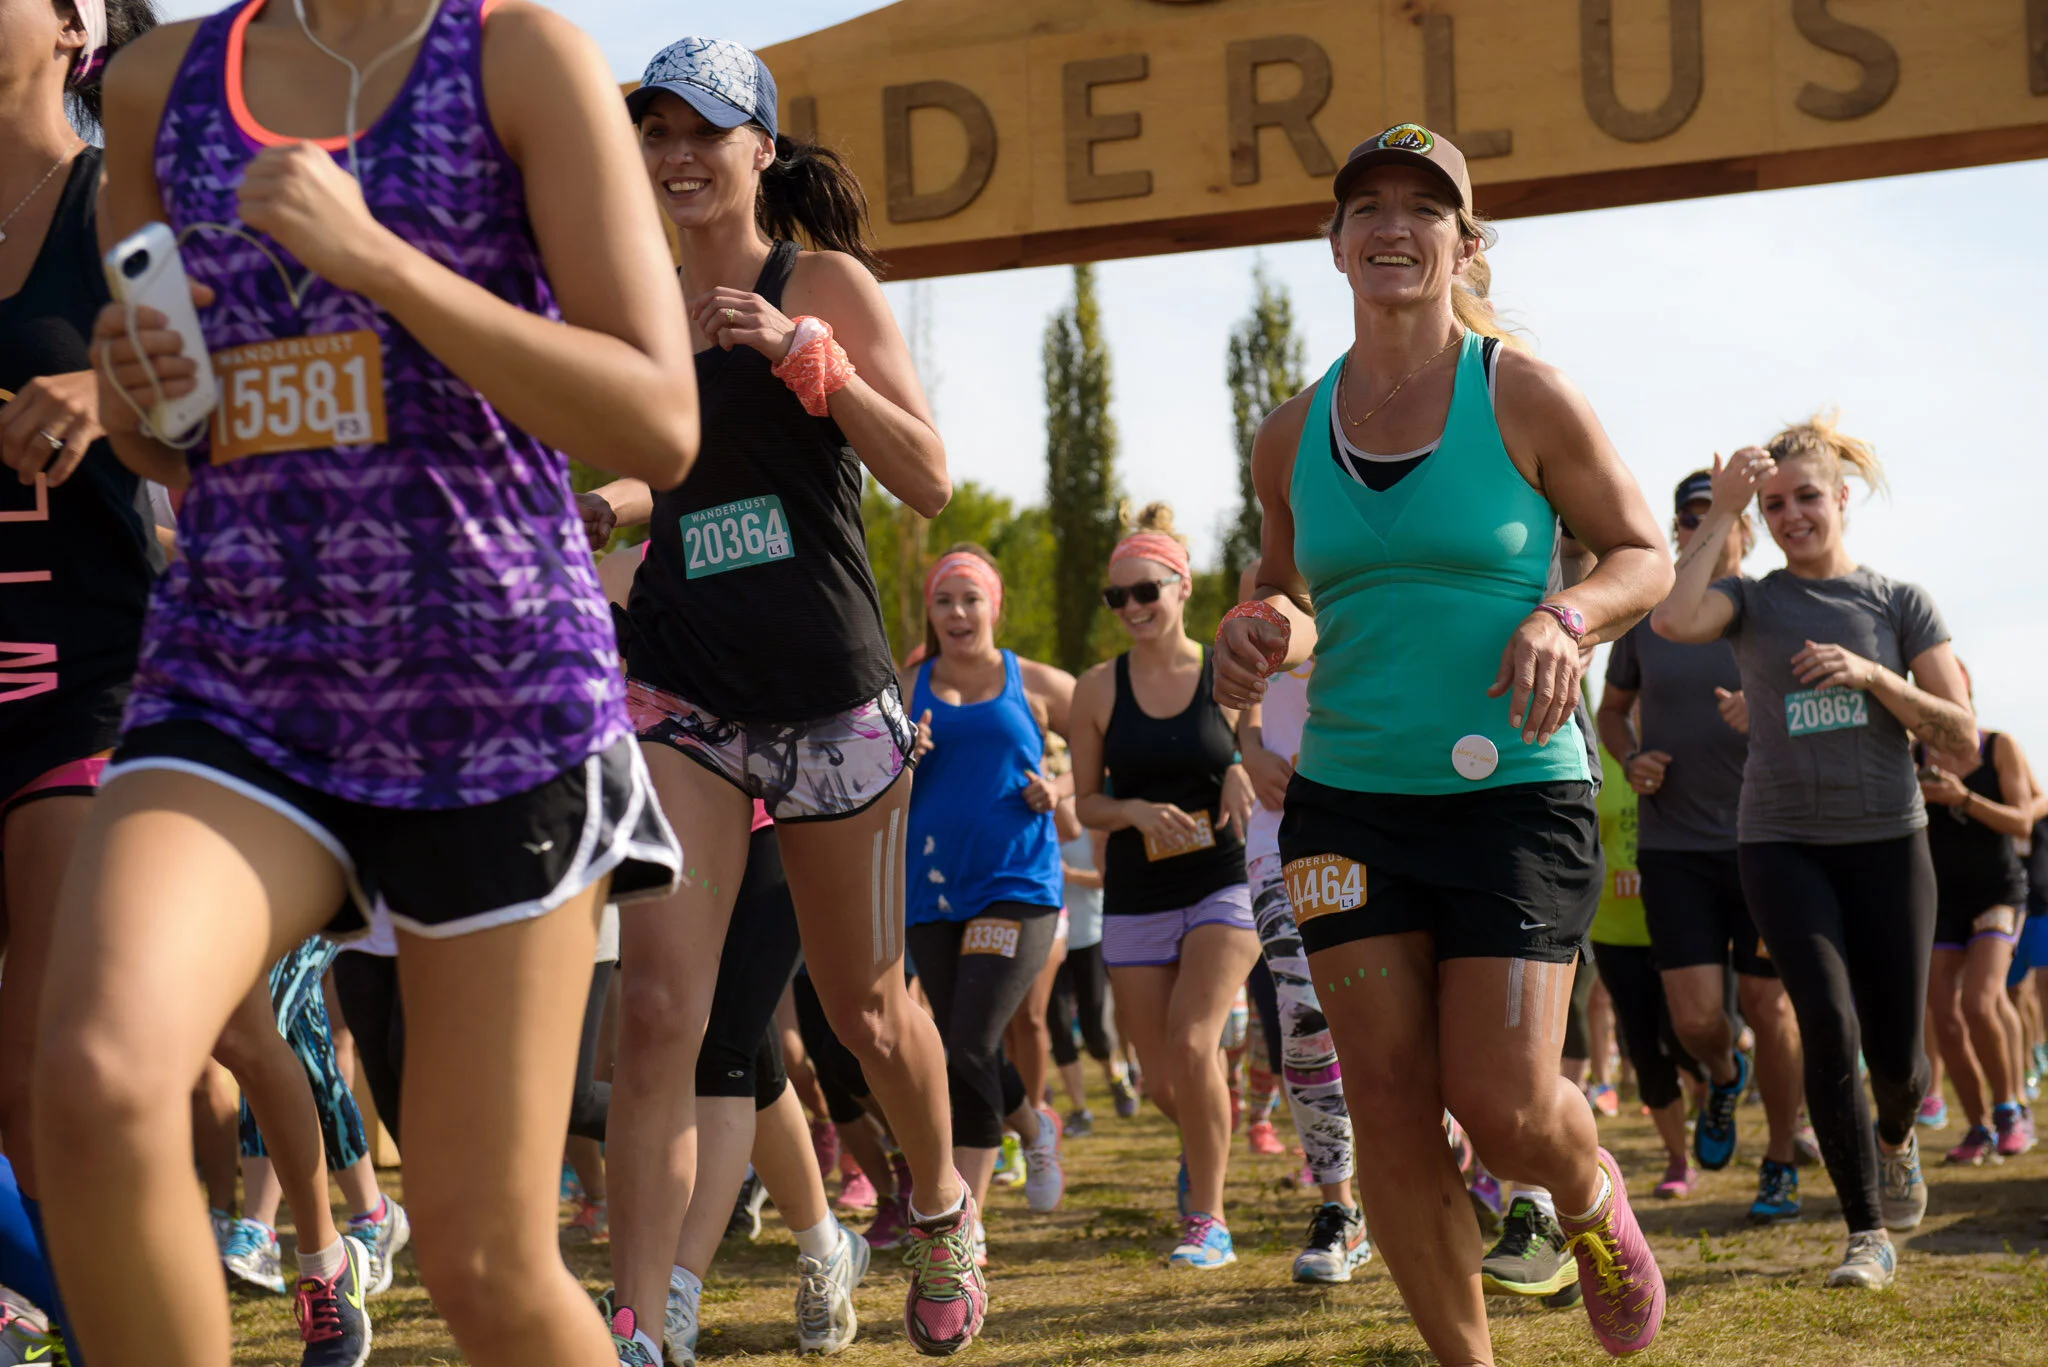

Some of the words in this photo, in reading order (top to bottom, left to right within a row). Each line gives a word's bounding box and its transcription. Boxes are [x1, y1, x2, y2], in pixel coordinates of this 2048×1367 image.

[789, 0, 2048, 224] DERLUS
[690, 497, 768, 523] WANDERLUST
[685, 508, 788, 570] 20364
[769, 544, 783, 555] L1
[1787, 693, 1863, 731] 20862
[1285, 853, 1350, 874] WANDERLUS
[1341, 898, 1354, 908] L1
[964, 925, 1019, 950] 13399
